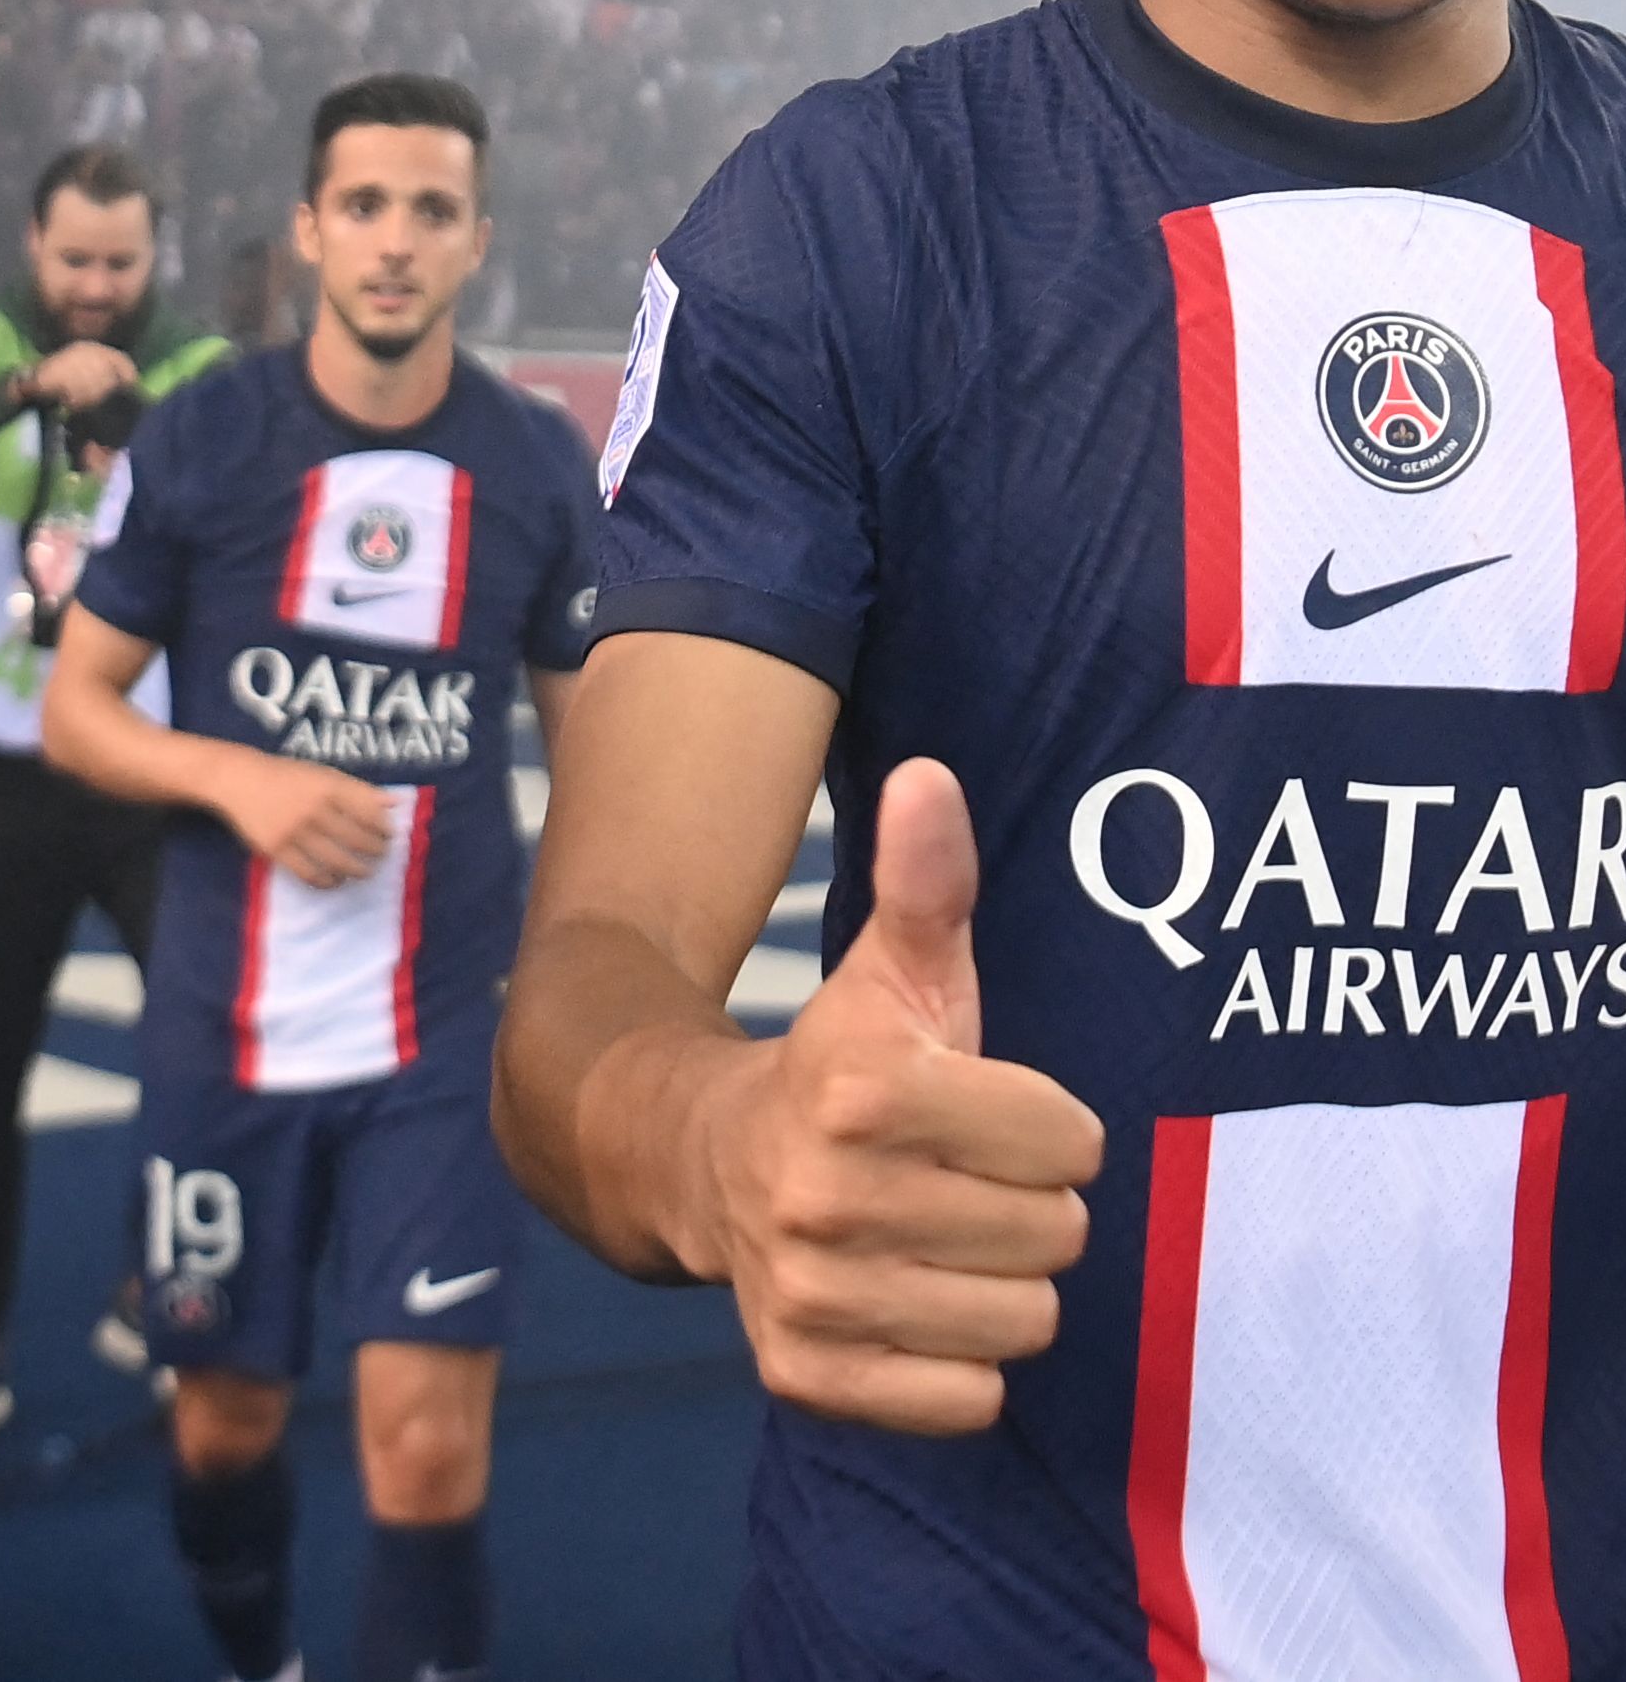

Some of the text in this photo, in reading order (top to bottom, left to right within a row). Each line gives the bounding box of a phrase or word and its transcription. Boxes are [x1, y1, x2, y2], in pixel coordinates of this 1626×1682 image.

[1343, 324, 1449, 366] PARIS
[1353, 437, 1460, 474] SAINT GERMAIN
[228, 646, 476, 733] QATAR
[142, 1154, 245, 1280] 19
